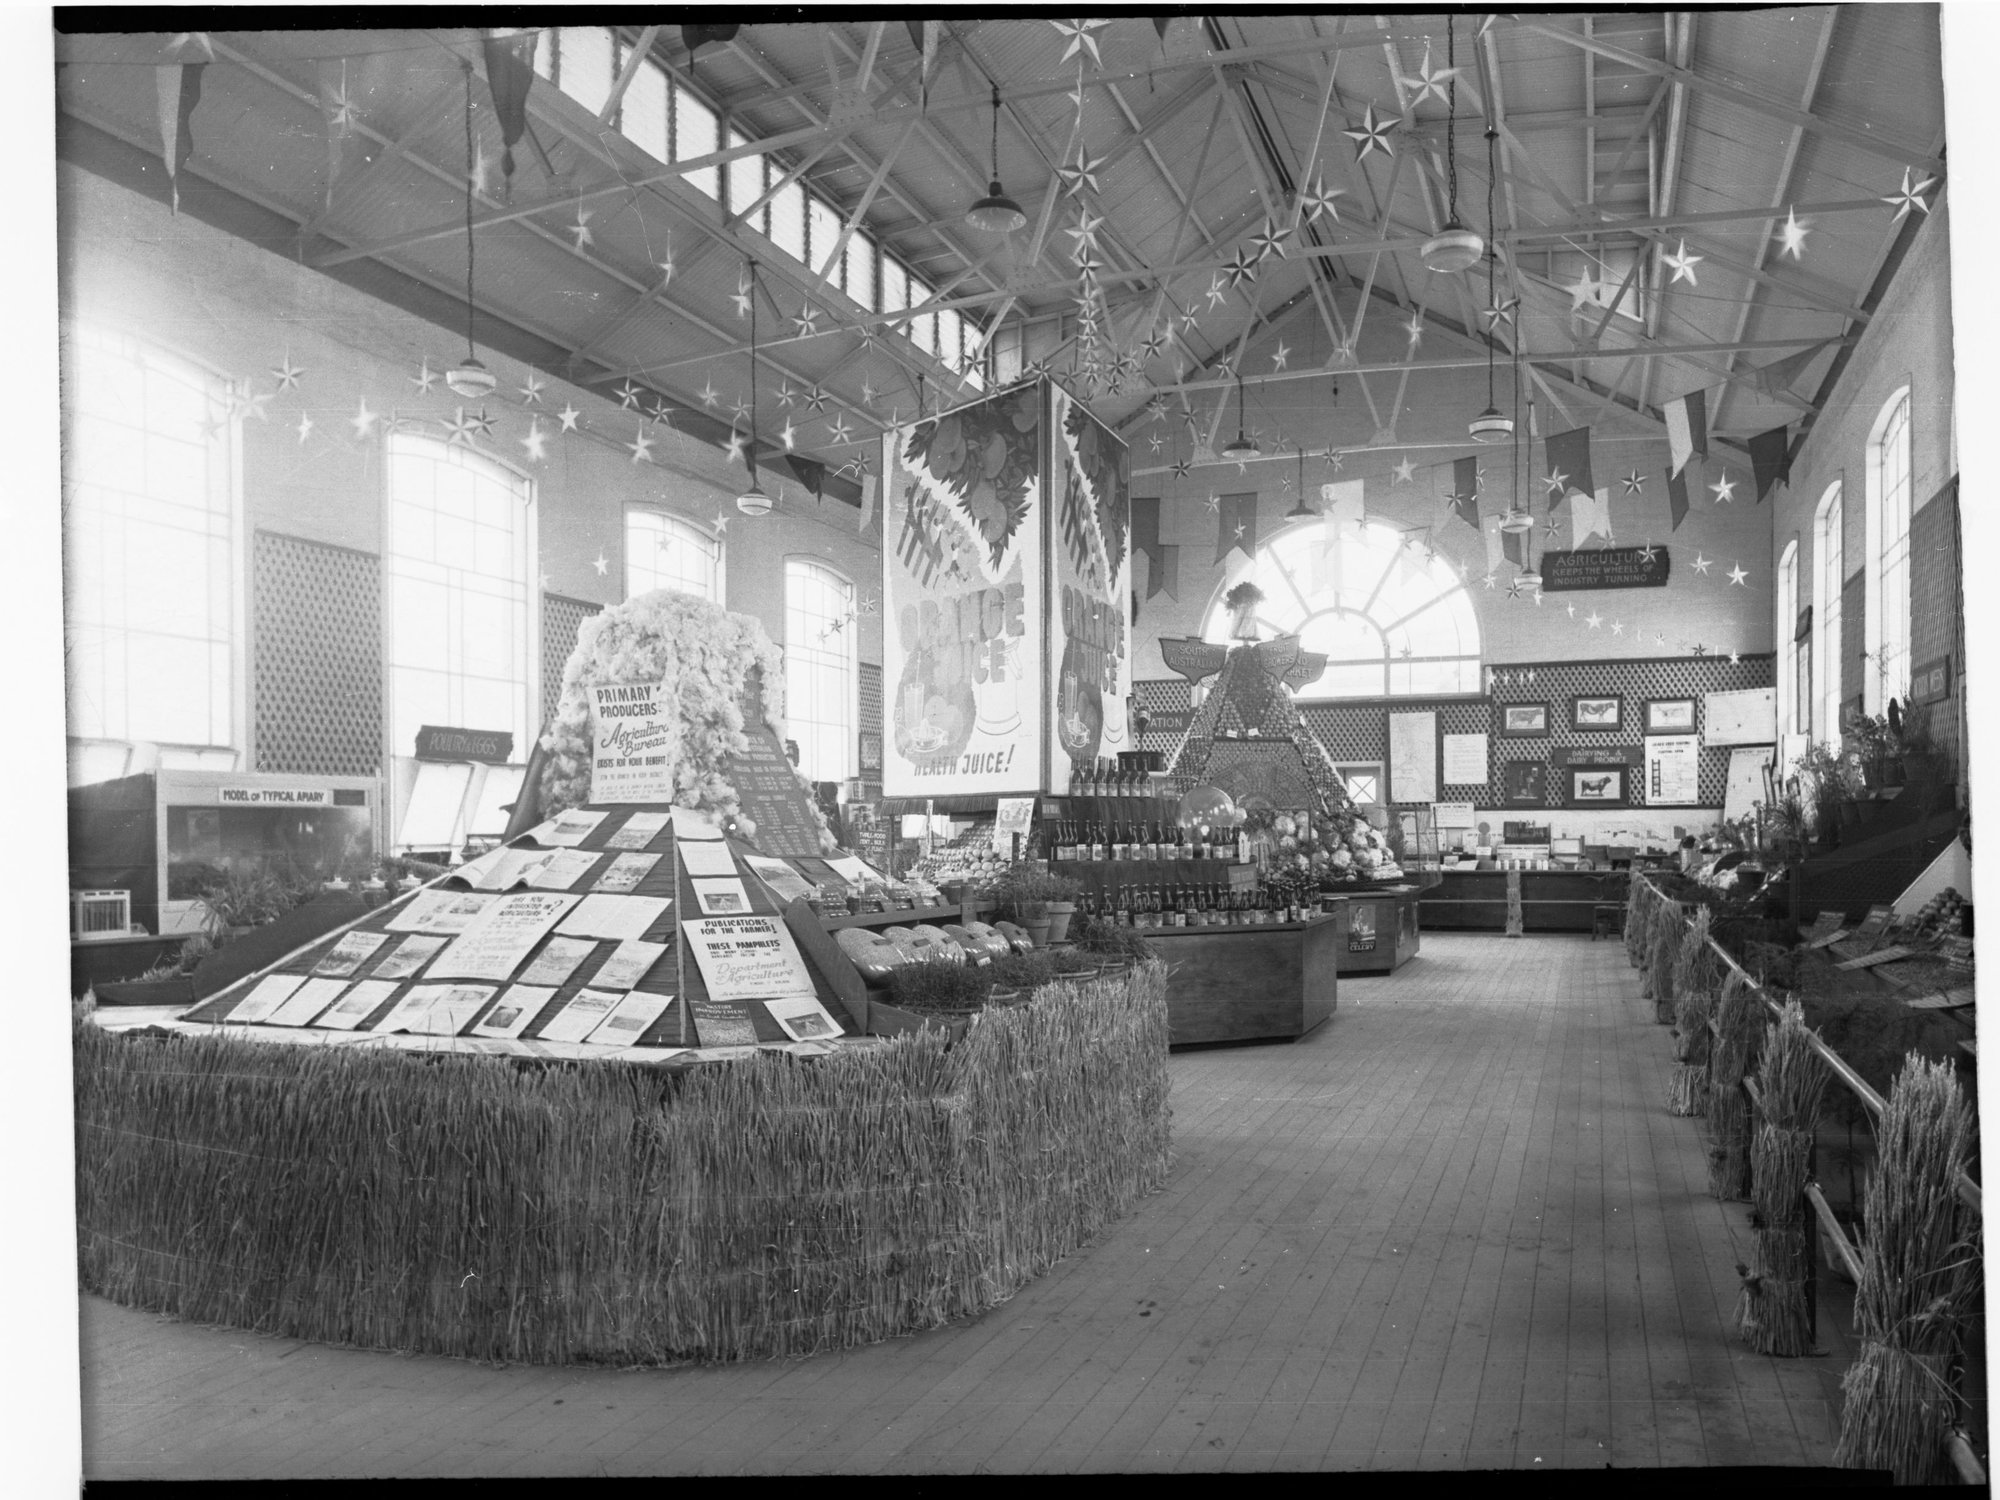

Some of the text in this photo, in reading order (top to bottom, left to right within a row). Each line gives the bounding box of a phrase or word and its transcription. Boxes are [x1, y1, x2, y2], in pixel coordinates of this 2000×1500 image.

[1556, 551, 1653, 567] AGRICULTUR
[1552, 563, 1654, 577] KEEPS THE WHEELS OF
[1554, 573, 1647, 586] INDUSTRY TURNING
[900, 582, 1025, 654] ORANGE
[1287, 667, 1313, 680] ARKET
[597, 686, 651, 703] PRIMARY
[1149, 717, 1183, 728] ATION
[622, 736, 668, 757] Bureau
[597, 758, 614, 769] EXISTS
[616, 757, 626, 768] FOR
[915, 743, 1016, 777] HEALTH JUICE!
[1593, 755, 1627, 764] PRODUCE
[223, 789, 249, 801] MODEL
[262, 790, 294, 802] TYPICAL
[297, 791, 325, 802] APIARY
[701, 923, 778, 935] FOR THE FARMER!
[705, 918, 768, 928] PUBLICATIONS
[706, 940, 781, 951] THESE PAMPHLETS
[716, 958, 786, 977] Department
[716, 968, 794, 986] Agriculture
